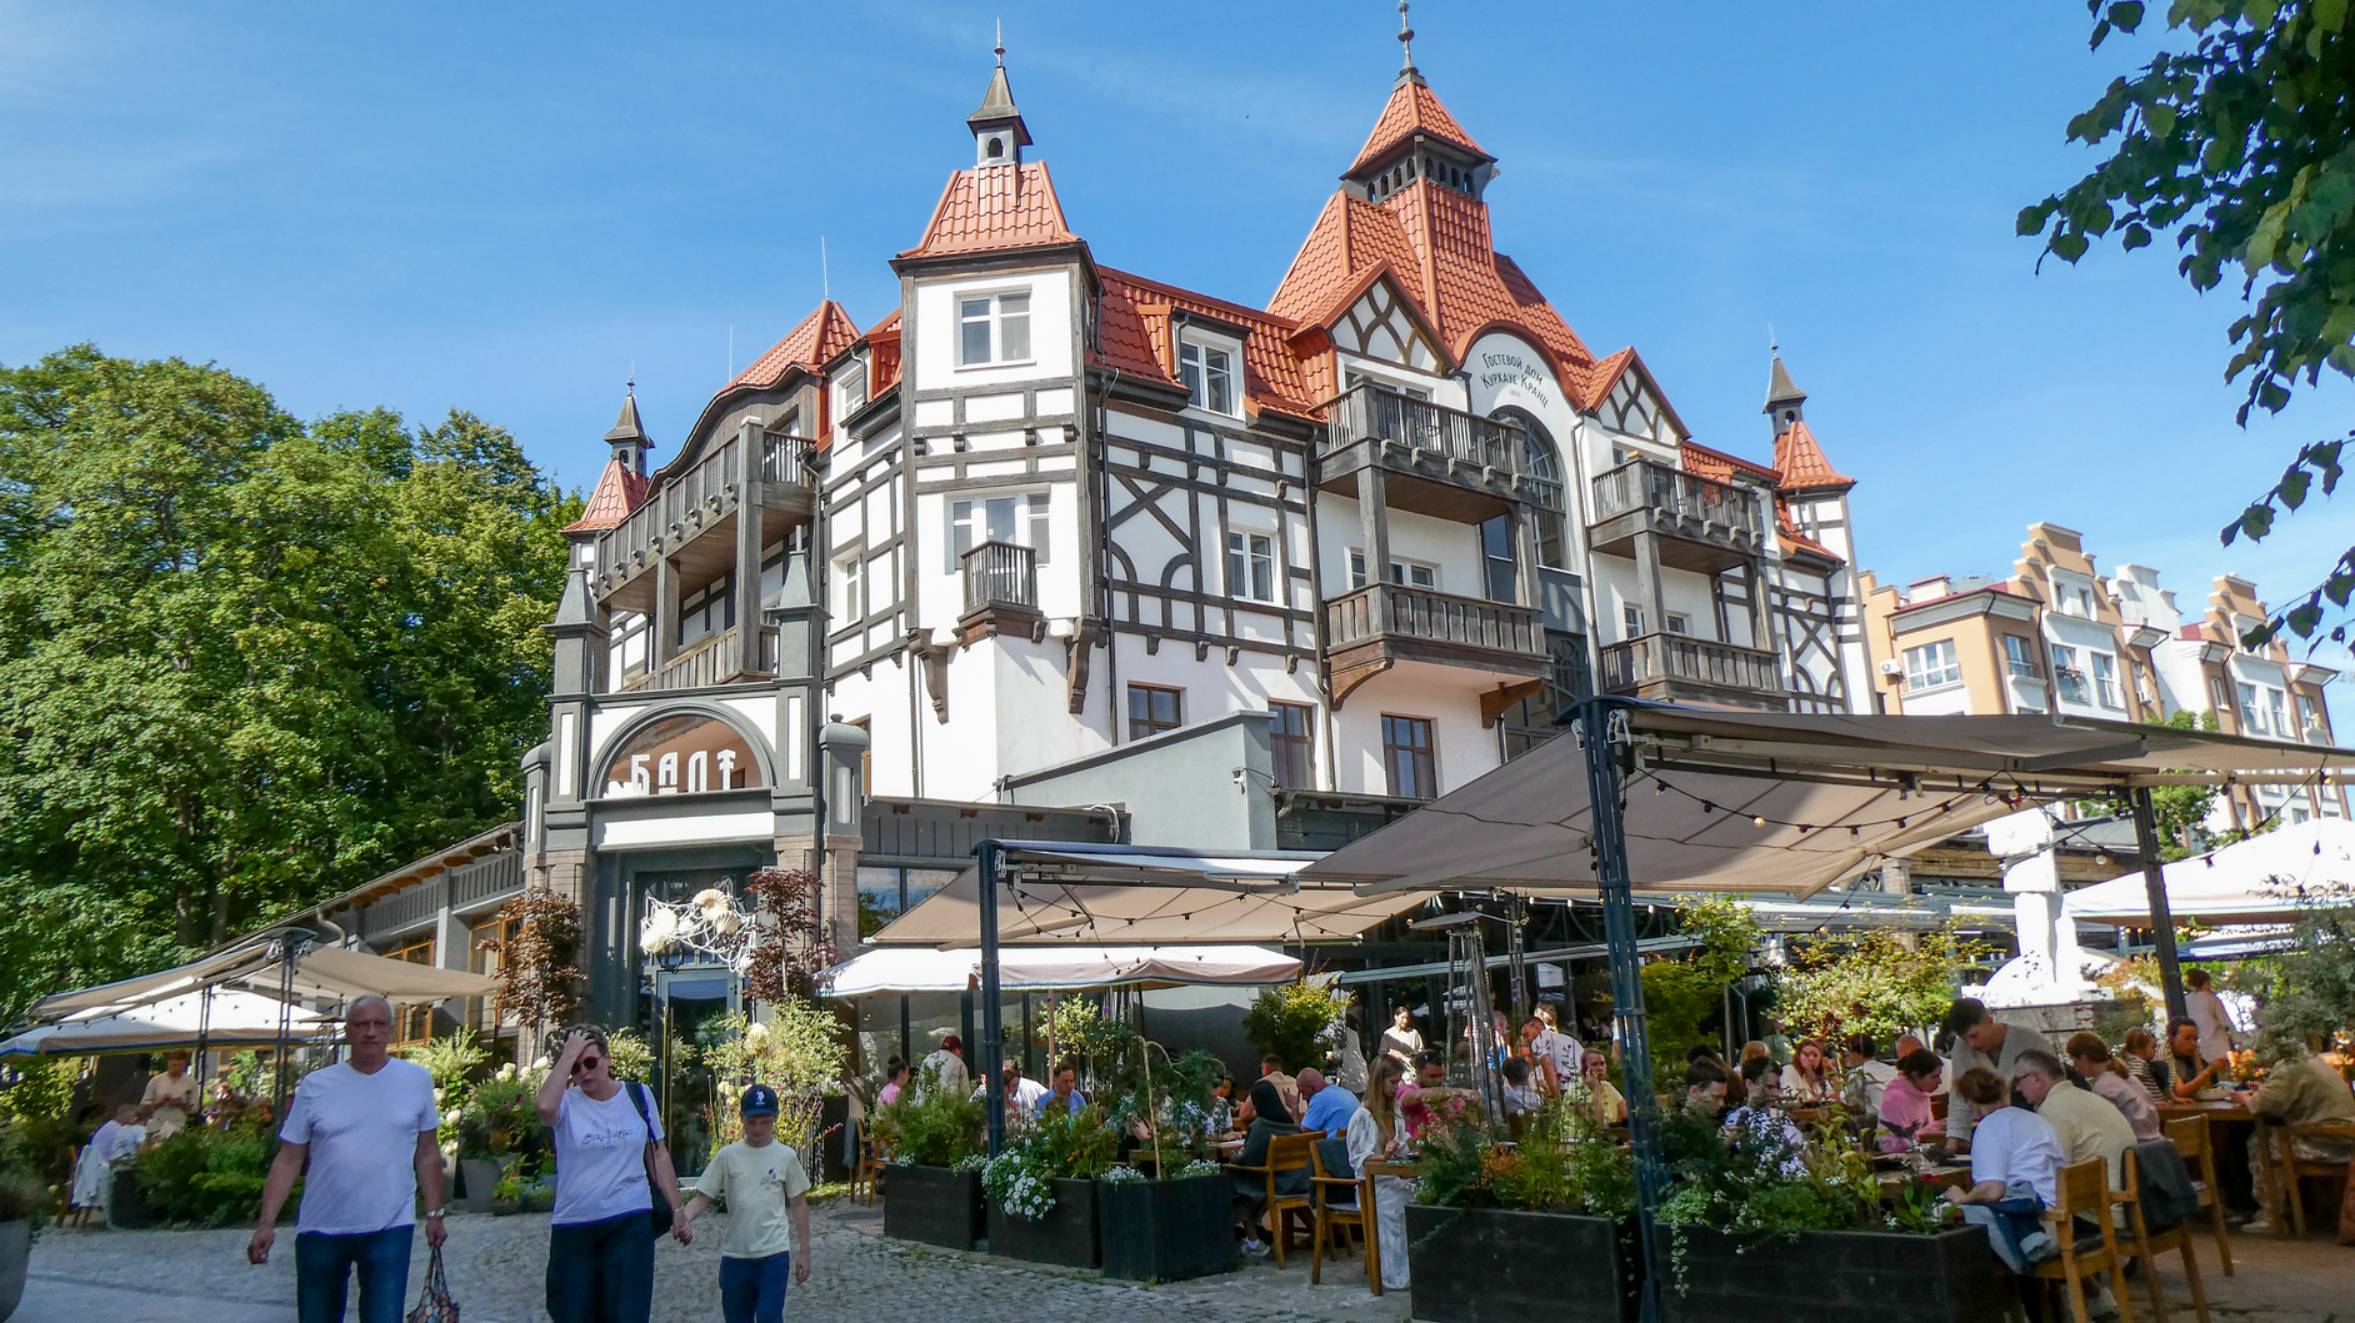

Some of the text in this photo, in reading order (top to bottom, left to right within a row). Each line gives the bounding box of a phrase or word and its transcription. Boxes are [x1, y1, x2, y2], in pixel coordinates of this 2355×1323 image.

[1482, 352, 1543, 384] ГОСТЕВОЙ ДОМ
[1480, 373, 1549, 408] КУРХАУС КРАНЦ
[631, 749, 736, 796] БАЛТ
